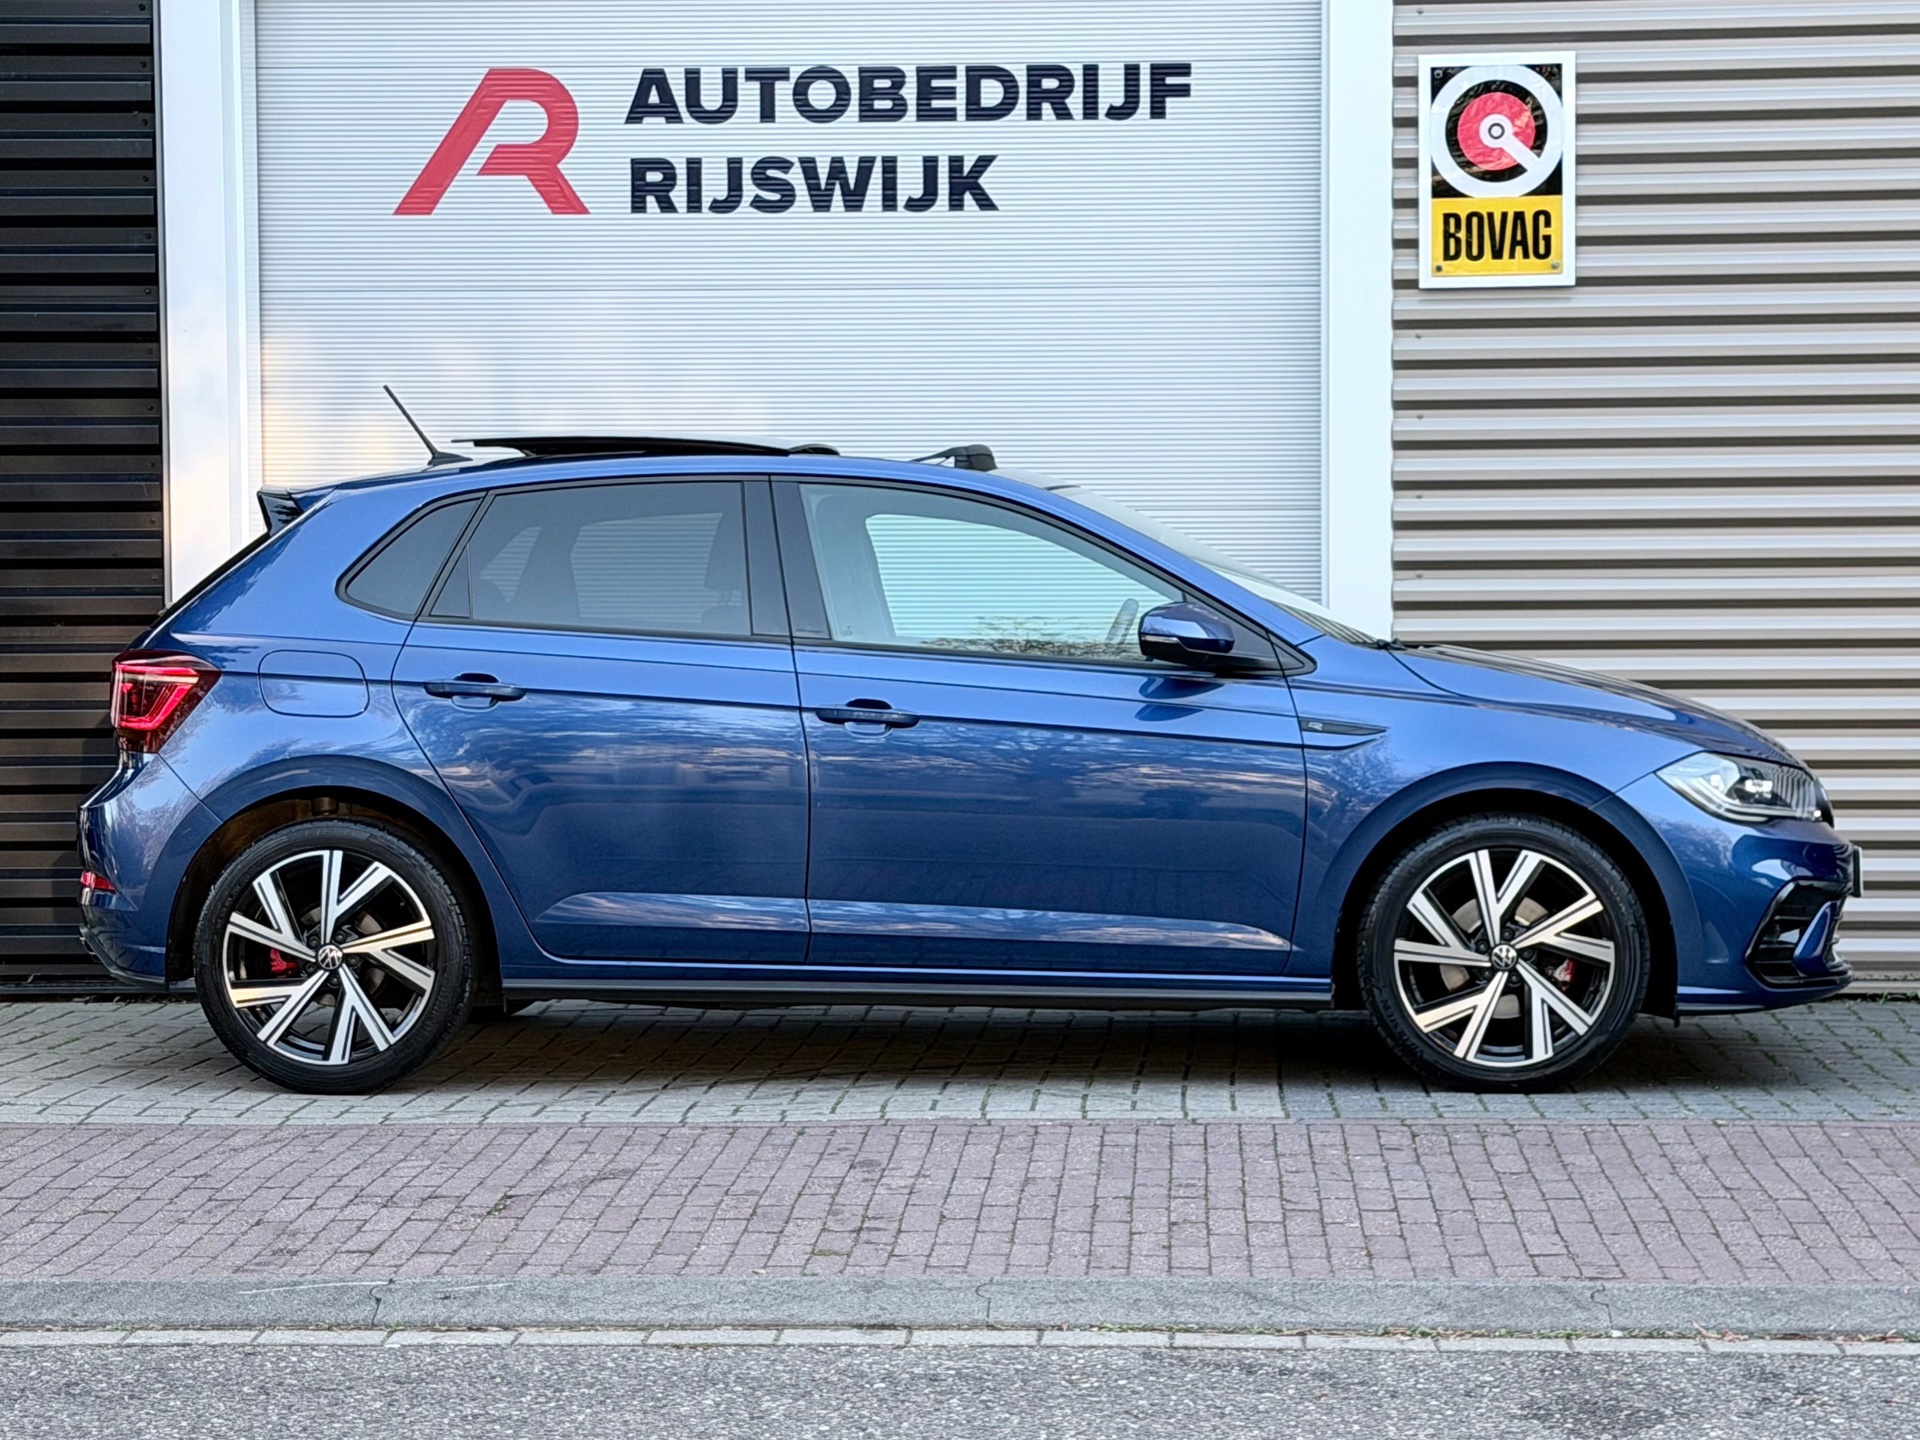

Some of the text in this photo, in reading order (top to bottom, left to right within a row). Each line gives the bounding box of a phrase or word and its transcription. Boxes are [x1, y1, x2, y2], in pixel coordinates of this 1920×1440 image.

[625, 62, 1192, 125] AUTOBEDRIJF
[630, 154, 999, 214] RIJSWIJK
[1442, 209, 1553, 262] BOVAG
